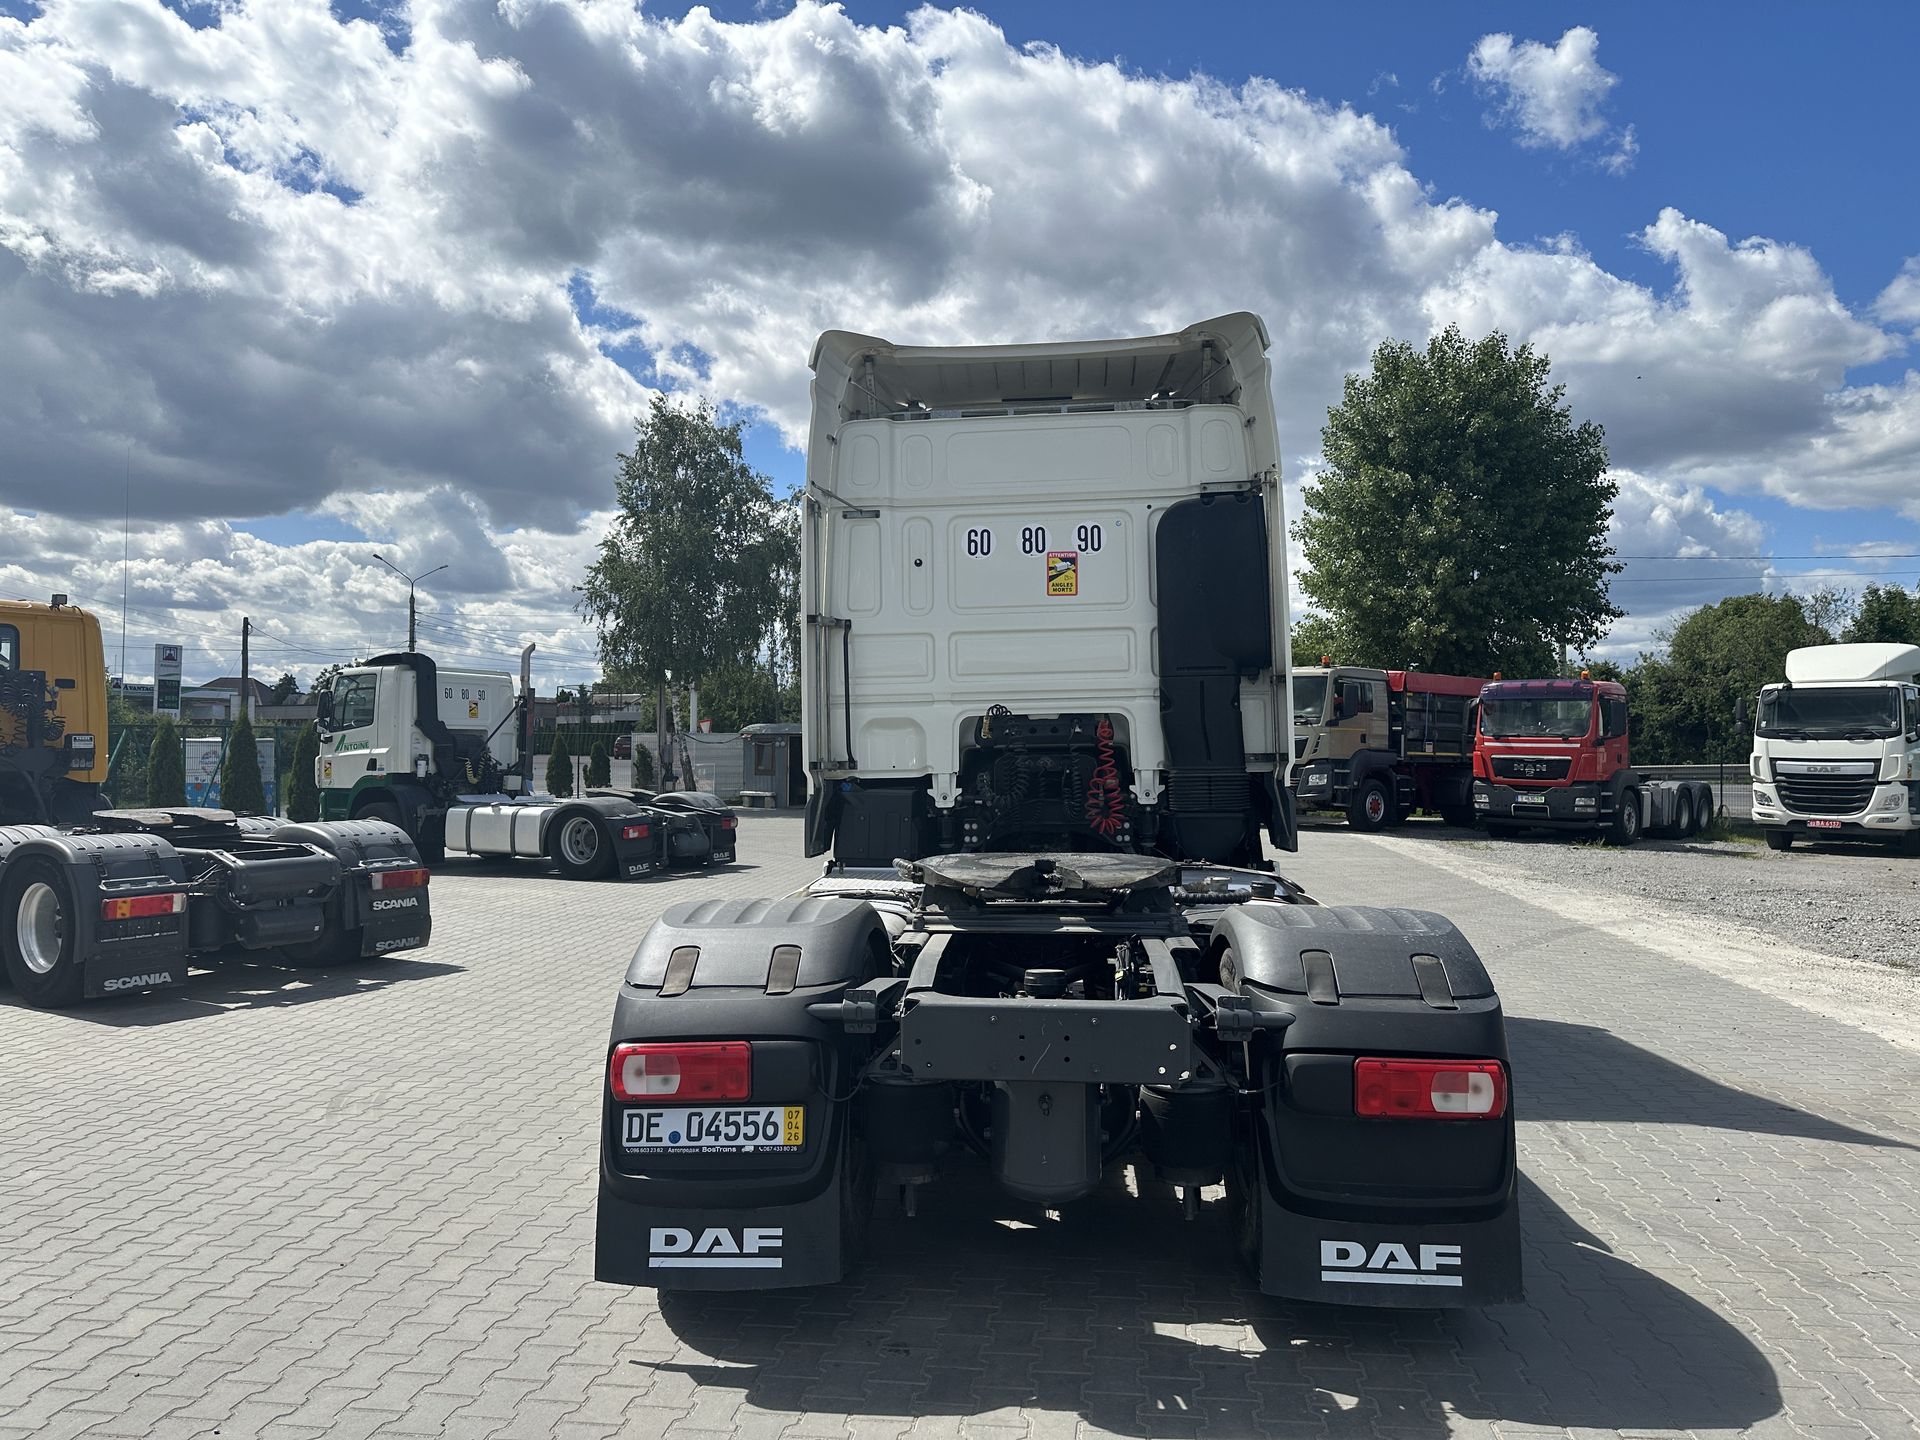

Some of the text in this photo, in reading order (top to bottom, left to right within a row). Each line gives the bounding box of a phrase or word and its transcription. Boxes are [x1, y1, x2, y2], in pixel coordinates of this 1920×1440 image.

[967, 524, 1101, 556] 60 80 90
[123, 684, 155, 692] AVANTAG
[444, 687, 486, 701] 60 80 90
[335, 734, 369, 752] ANTOINE
[1513, 763, 1547, 772] MAN
[628, 863, 650, 873] DAF
[372, 897, 418, 911] SCANIA
[375, 936, 420, 952] SCANIA
[103, 972, 172, 991] SCANIA
[787, 1110, 800, 1120] 07
[625, 1110, 779, 1142] DE 04556
[787, 1121, 799, 1130] 04
[787, 1132, 800, 1141] 26
[649, 1227, 783, 1254] DAF
[1320, 1240, 1462, 1270] DAF
